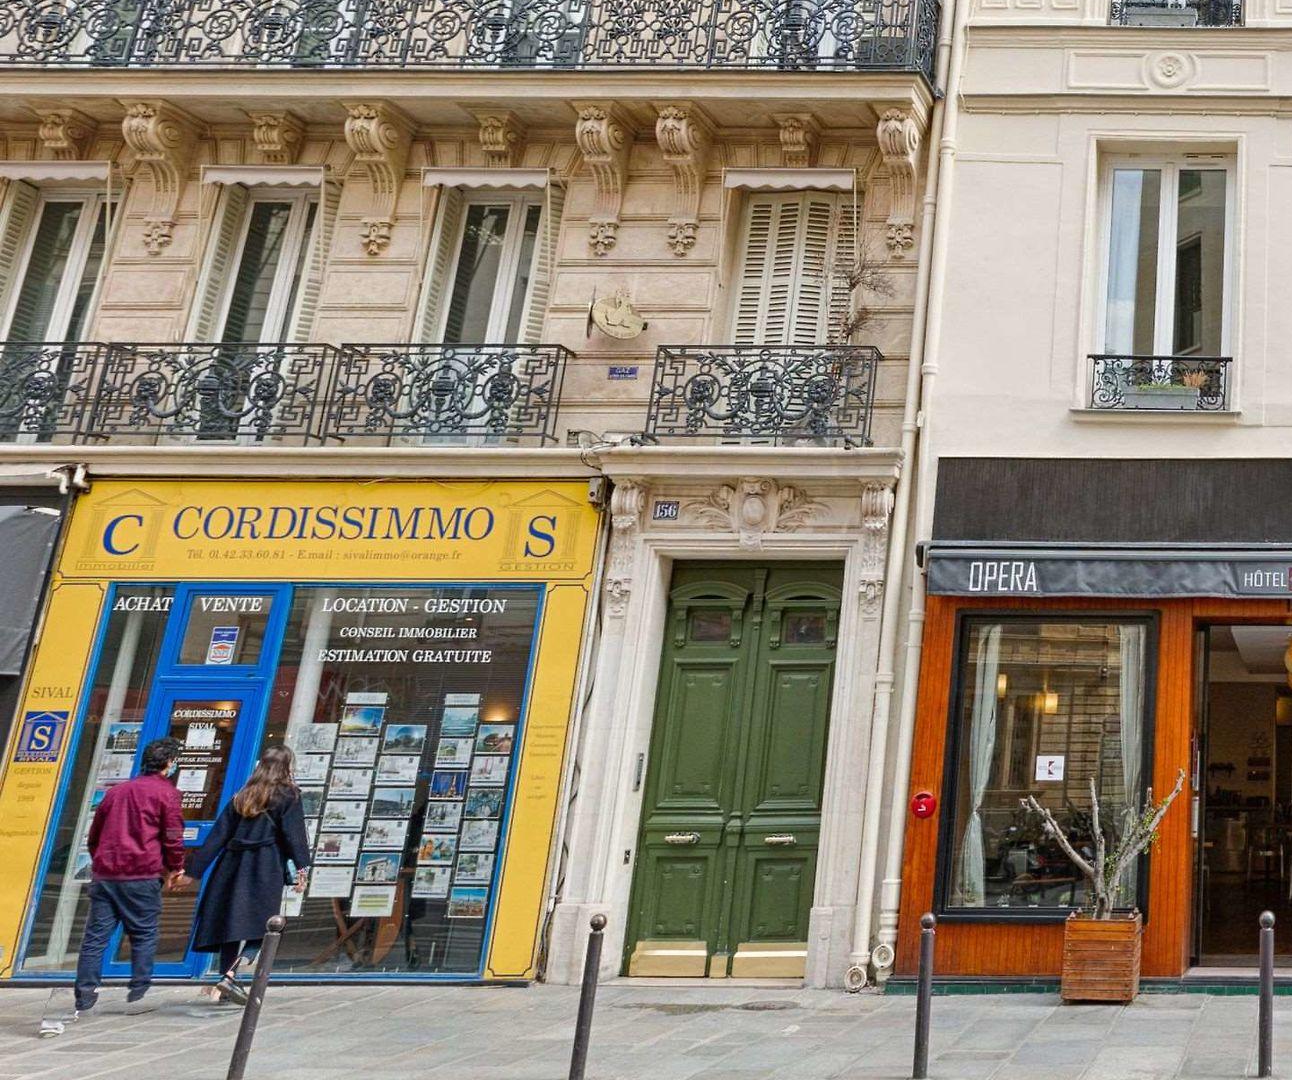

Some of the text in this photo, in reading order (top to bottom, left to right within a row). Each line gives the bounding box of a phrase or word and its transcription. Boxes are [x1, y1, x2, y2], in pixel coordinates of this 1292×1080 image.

[656, 504, 677, 518] 156
[173, 506, 495, 540] CORDISSIMMO
[102, 514, 144, 555] C
[524, 515, 557, 558] S
[499, 562, 575, 571] GESTION
[969, 561, 1037, 591] OPERA
[1244, 569, 1288, 587] HÔTEL
[113, 596, 264, 612] ACHAT VENTE
[322, 597, 409, 613] LOCATION
[424, 598, 507, 614] GESTION
[340, 627, 478, 639] CONSEIL IMMOBILIER
[317, 649, 492, 663] ESTIMATION GRATUITE
[31, 686, 74, 699] SIVAL
[173, 709, 237, 719] CORDISSIMMO
[30, 725, 51, 751] S
